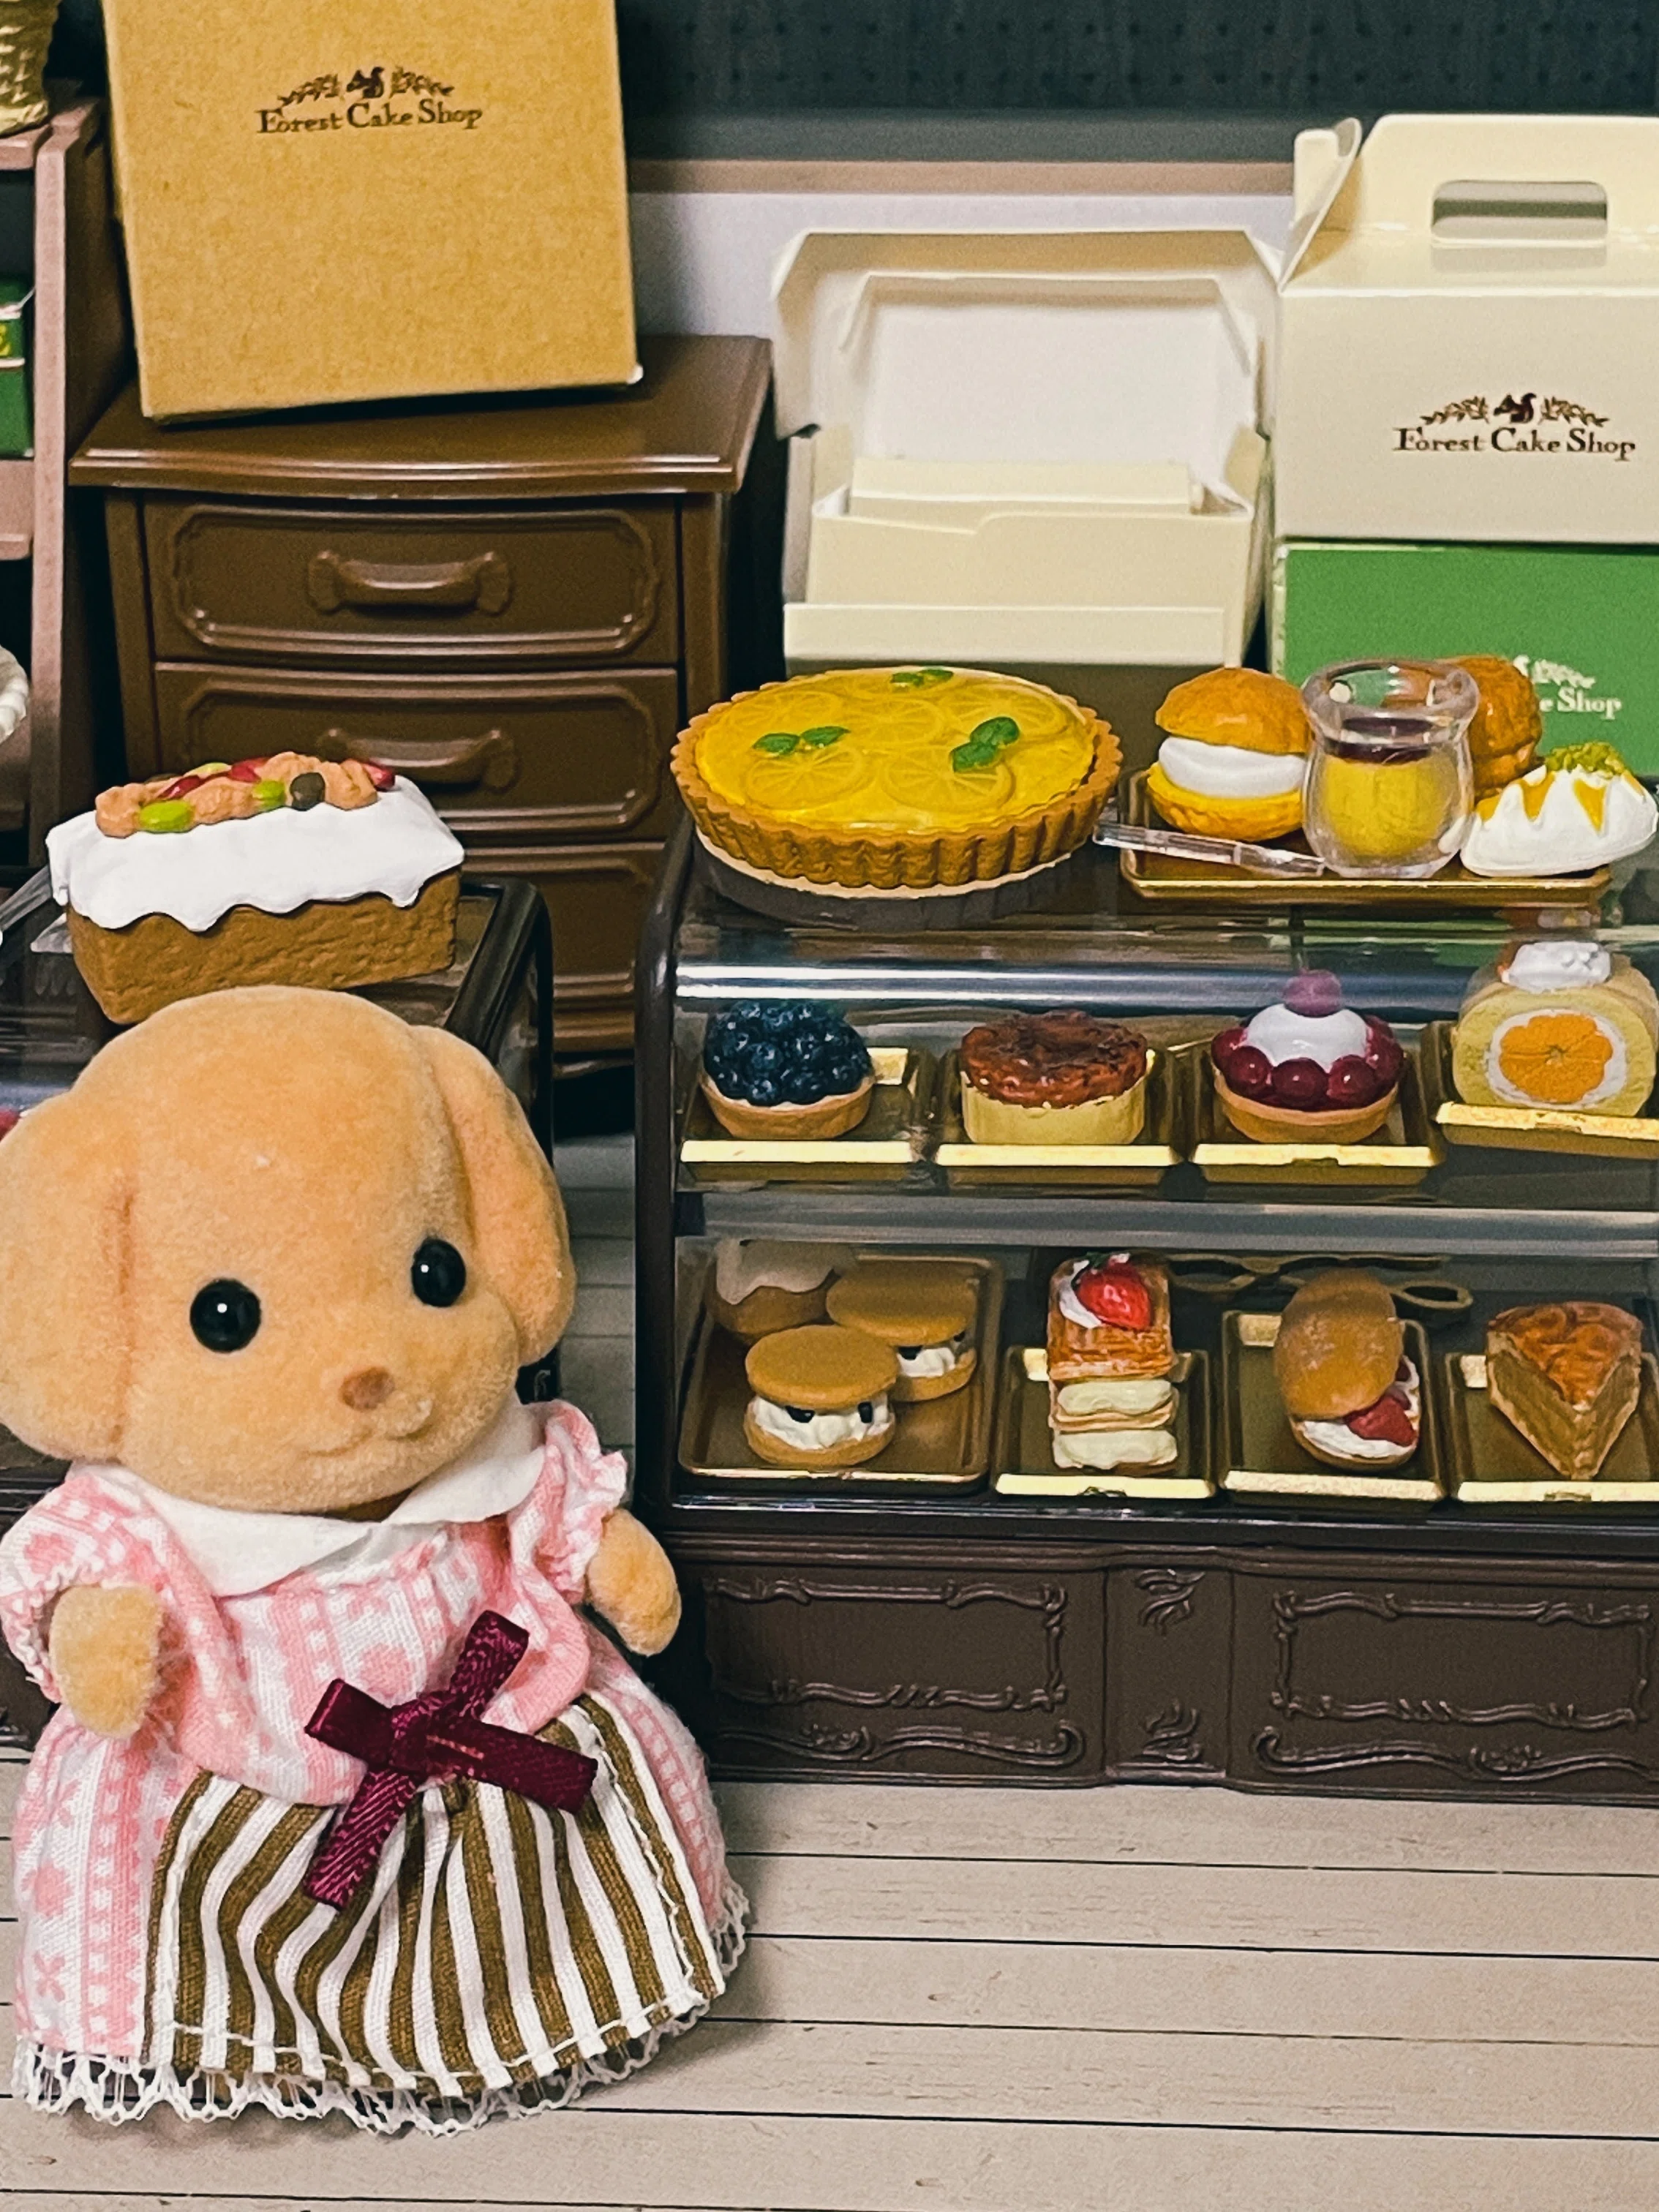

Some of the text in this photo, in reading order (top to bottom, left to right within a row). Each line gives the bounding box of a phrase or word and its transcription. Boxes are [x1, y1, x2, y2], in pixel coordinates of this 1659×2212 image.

[255, 98, 484, 133] Forest Cake Shop
[1391, 426, 1636, 462] Forest Cake Shop
[1557, 686, 1622, 721] Shop
